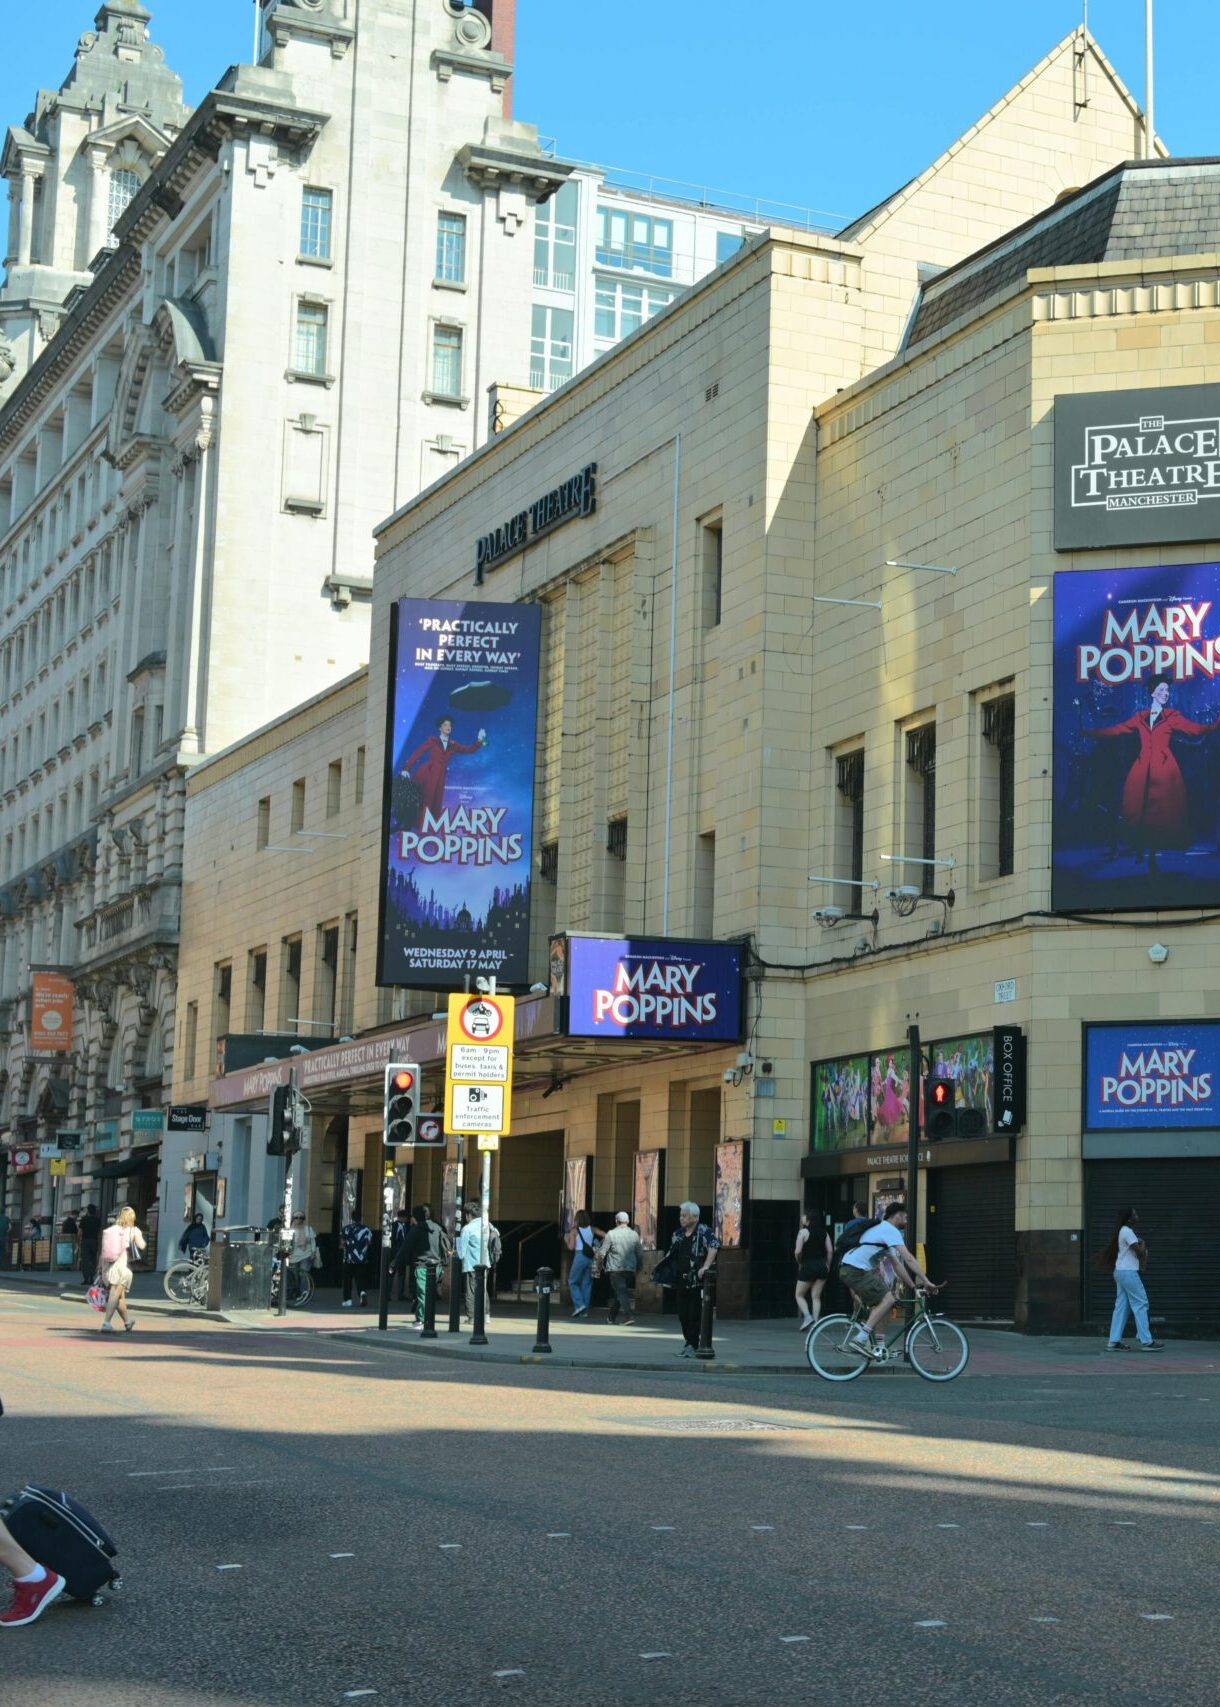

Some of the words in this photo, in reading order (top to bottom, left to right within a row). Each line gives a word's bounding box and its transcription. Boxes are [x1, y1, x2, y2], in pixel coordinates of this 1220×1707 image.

[1142, 419, 1162, 429] THE
[1090, 429, 1218, 466] PALACE
[1108, 492, 1196, 508] MANCHESTER
[473, 509, 528, 587] PALACE
[529, 462, 597, 535] THEATRE
[1104, 602, 1211, 645] MARY
[439, 634, 500, 649] PERFECT
[415, 648, 433, 661] IN
[436, 649, 482, 663] EVERY
[422, 805, 507, 835] MARY
[401, 831, 522, 864] POPPINS
[403, 947, 469, 958] WEDNESDAY
[470, 949, 477, 958] 9
[478, 950, 508, 960] APRIL
[409, 958, 464, 969] SATURDAY
[466, 959, 477, 969] 17
[478, 961, 502, 970] MAY
[616, 961, 701, 994] MARY
[595, 989, 717, 1025] POPPINS
[341, 1047, 365, 1065] PERFECT
[366, 1045, 375, 1059] IN
[375, 1040, 395, 1058] EVERY
[460, 1046, 477, 1054] 6am
[483, 1047, 500, 1055] 9pm
[1002, 1035, 1013, 1060] BOX
[478, 1071, 505, 1079] holders
[1119, 1048, 1197, 1077] MARY
[1002, 1062, 1013, 1102] OFFICE
[1102, 1073, 1212, 1105] POPPINS
[171, 1113, 188, 1124] Stage
[188, 1114, 203, 1123] Door
[455, 1113, 500, 1121] enforcement
[466, 1105, 490, 1113] Traffic
